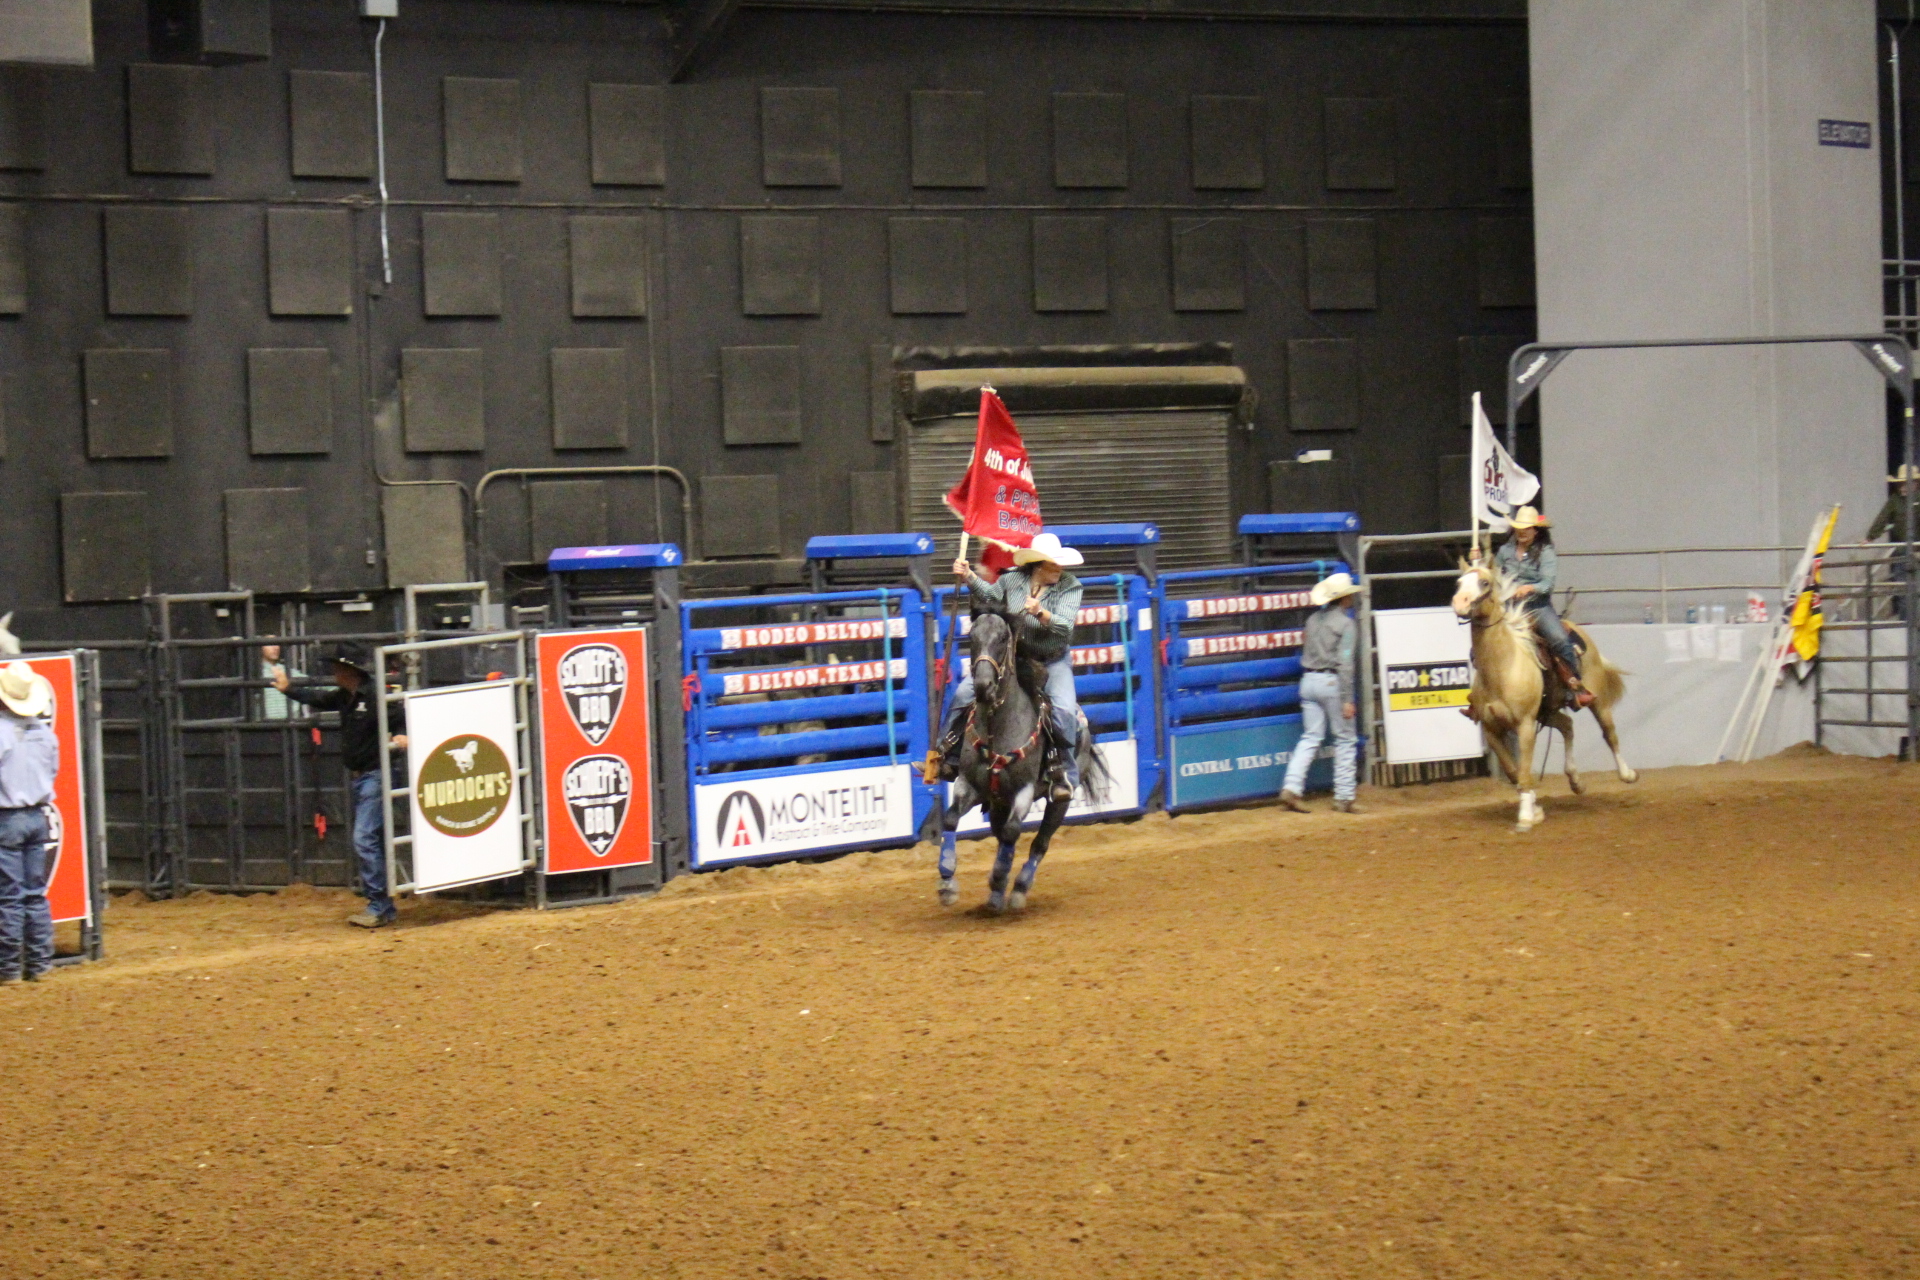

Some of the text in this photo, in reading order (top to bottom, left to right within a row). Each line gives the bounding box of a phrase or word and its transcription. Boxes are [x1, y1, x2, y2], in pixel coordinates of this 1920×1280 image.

[984, 448, 1004, 471] 4th
[1006, 457, 1021, 476] of
[995, 485, 1006, 505] &
[1206, 592, 1313, 615] RODEO BELTO
[745, 620, 885, 647] RODEO BELTON
[1388, 666, 1469, 690] PRO STAR
[579, 694, 611, 724] BBQ
[1180, 758, 1234, 777] CENTRAL
[1236, 753, 1273, 770] TEXAS
[423, 771, 508, 808] MURDOCH'S
[769, 783, 888, 827] MONTEITH
[583, 805, 615, 835] BBQ
